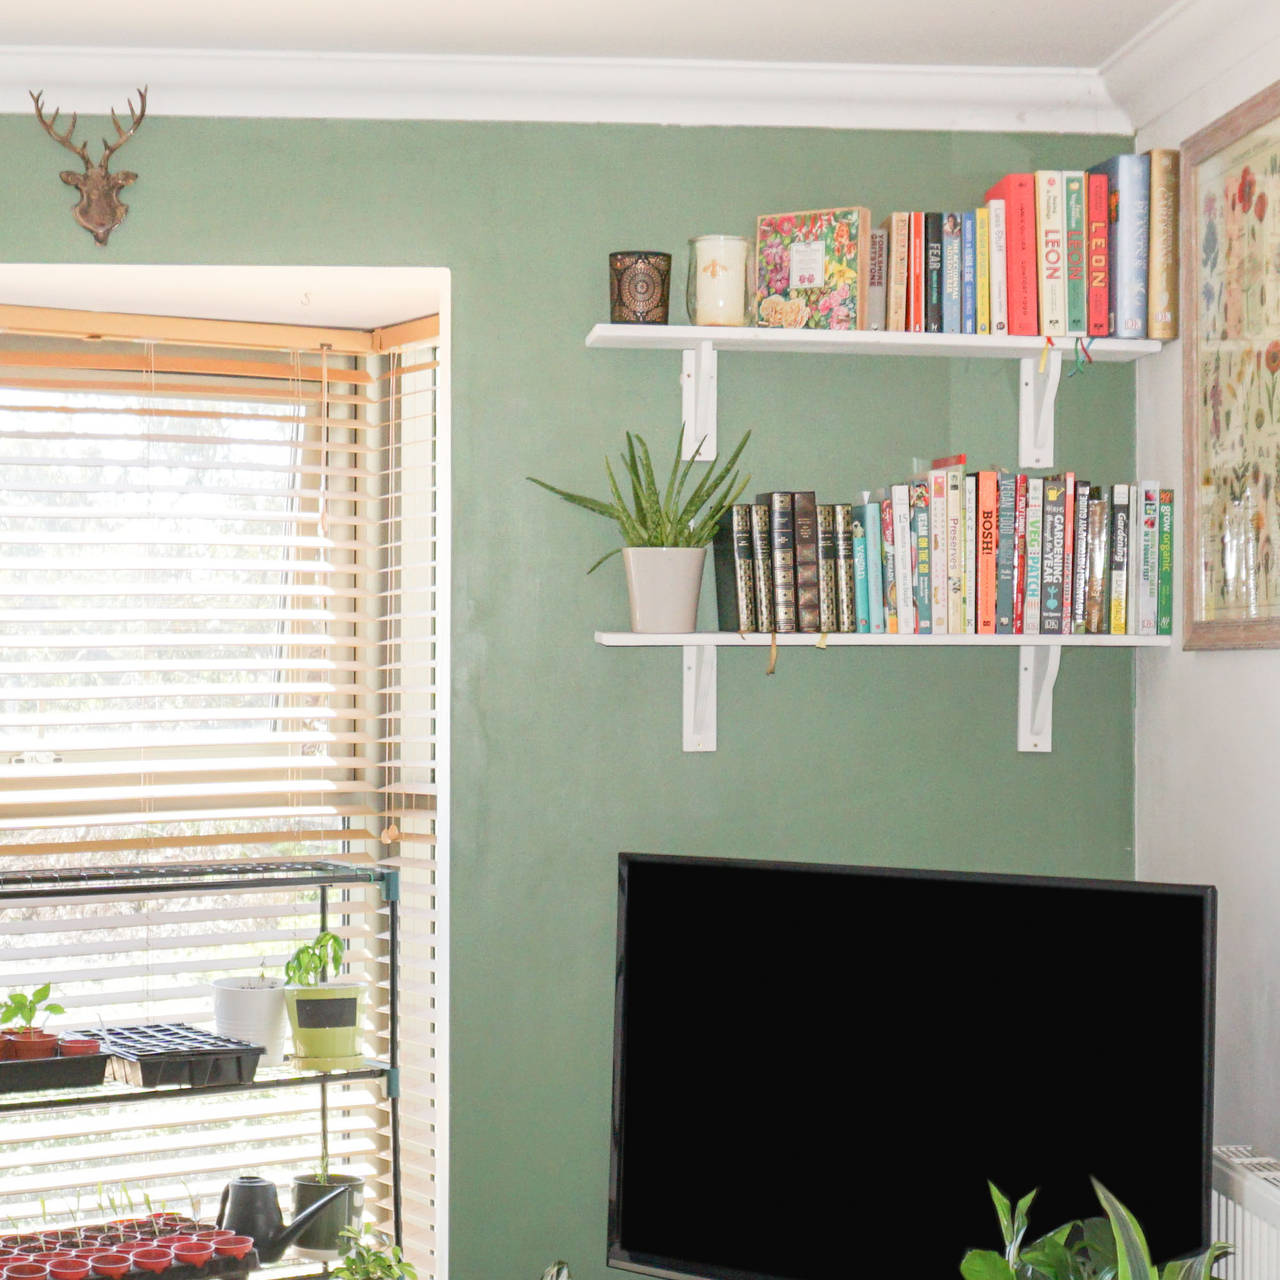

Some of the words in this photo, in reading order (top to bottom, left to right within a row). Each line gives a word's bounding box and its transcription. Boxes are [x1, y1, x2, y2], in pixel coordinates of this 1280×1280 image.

[929, 243, 941, 270] FEAR
[1045, 229, 1061, 279] LEON
[1067, 230, 1083, 280] LEON
[1091, 221, 1105, 287] LEON
[1000, 479, 1015, 508] VEGAN
[1078, 495, 1088, 519] GUIDE
[918, 512, 929, 536] VEGAN
[982, 510, 993, 556] BOSH!
[1029, 519, 1041, 548] VEG
[1115, 512, 1127, 562] Gardening
[1161, 505, 1172, 532] grow
[918, 537, 928, 547] ON
[918, 549, 928, 562] THE
[950, 518, 960, 570] Preserves
[1052, 514, 1063, 583] GARDENING
[1077, 519, 1087, 573] PHOTOGRAPHY
[1160, 533, 1171, 572] organic
[918, 563, 928, 574] GO
[1027, 556, 1040, 598] PATCH
[1043, 552, 1054, 583] YEAR
[1075, 573, 1085, 614] ADVANCED
